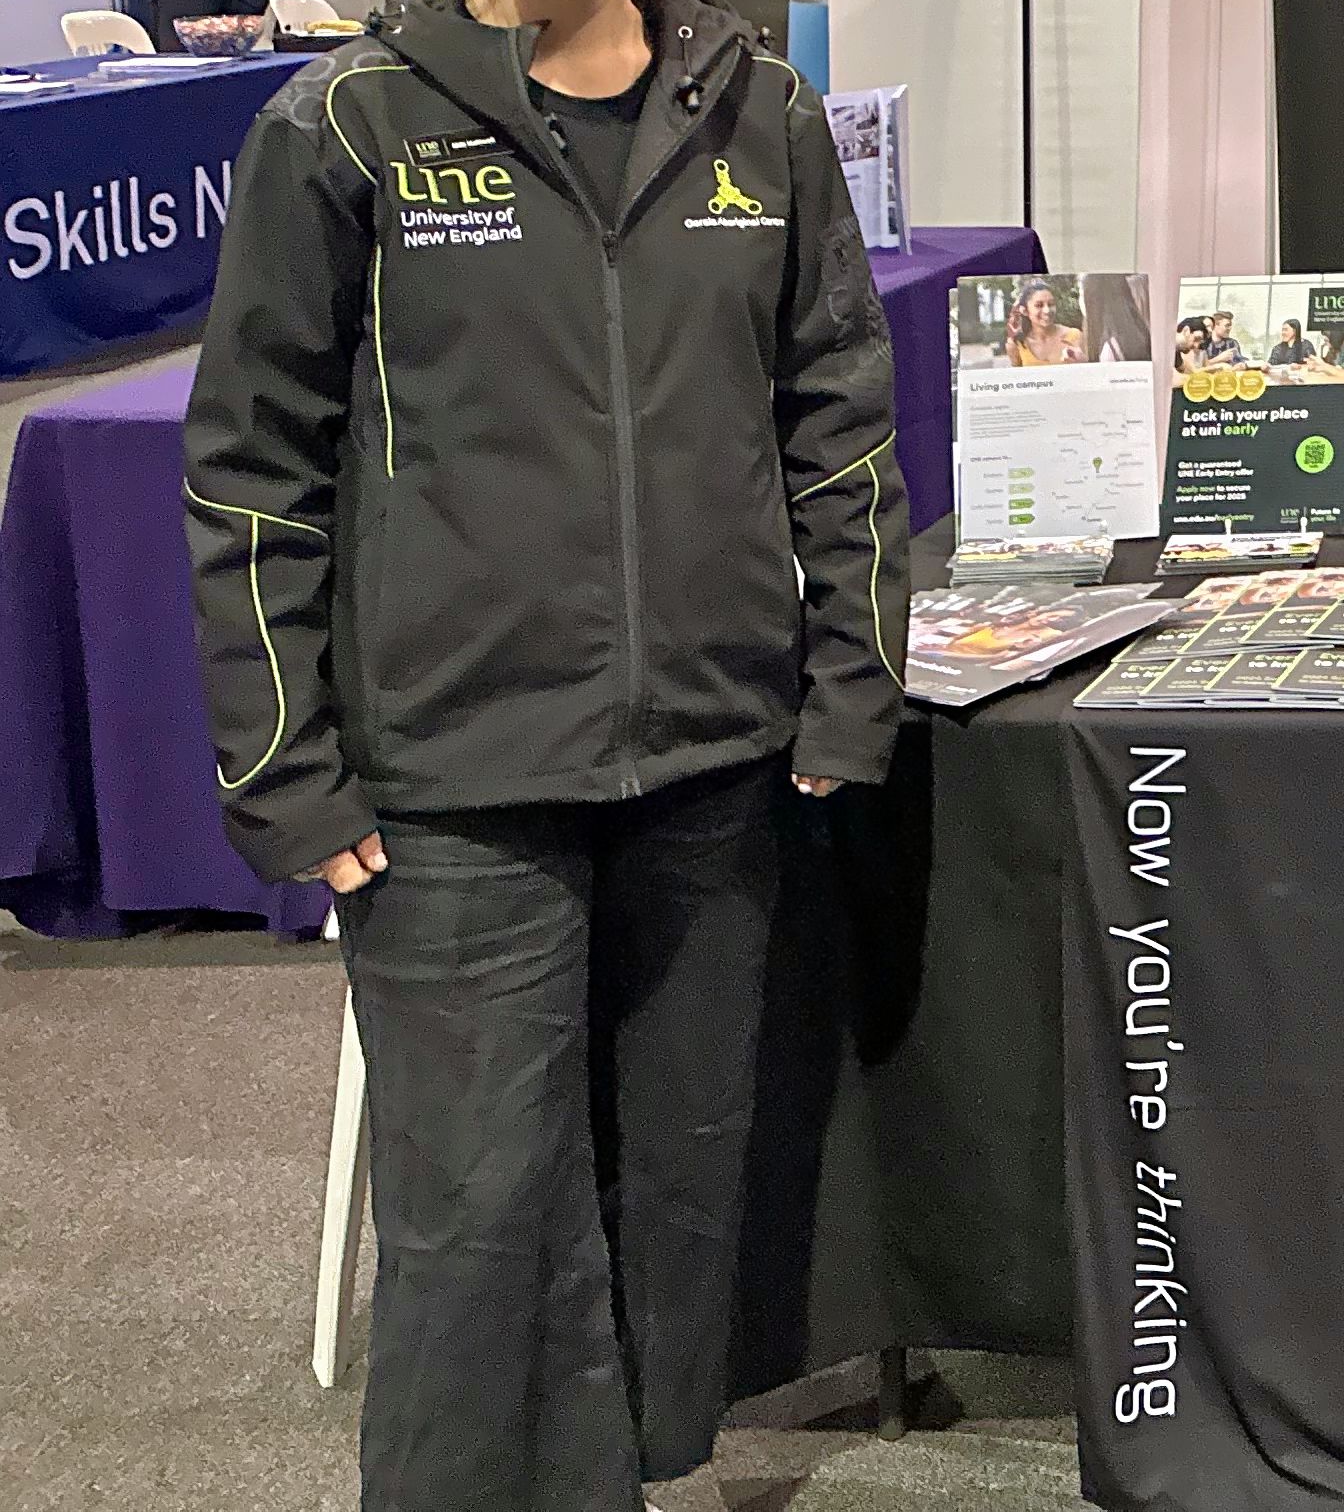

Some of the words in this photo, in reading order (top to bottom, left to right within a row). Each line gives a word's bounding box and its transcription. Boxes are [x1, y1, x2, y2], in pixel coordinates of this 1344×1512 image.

[389, 161, 516, 203] une
[4, 176, 178, 279] Skills
[401, 209, 492, 227] University
[495, 207, 514, 224] of
[404, 231, 446, 248] New
[450, 225, 522, 245] England
[1182, 425, 1196, 437] at
[1200, 424, 1221, 436] uni
[1224, 423, 1258, 438] early
[1183, 408, 1217, 422] Lock
[1220, 409, 1233, 421] in
[1236, 410, 1267, 423] your
[1270, 407, 1309, 422] place
[1128, 746, 1187, 888] Now
[1109, 919, 1186, 1131] you're
[1115, 1161, 1187, 1424] thinking
